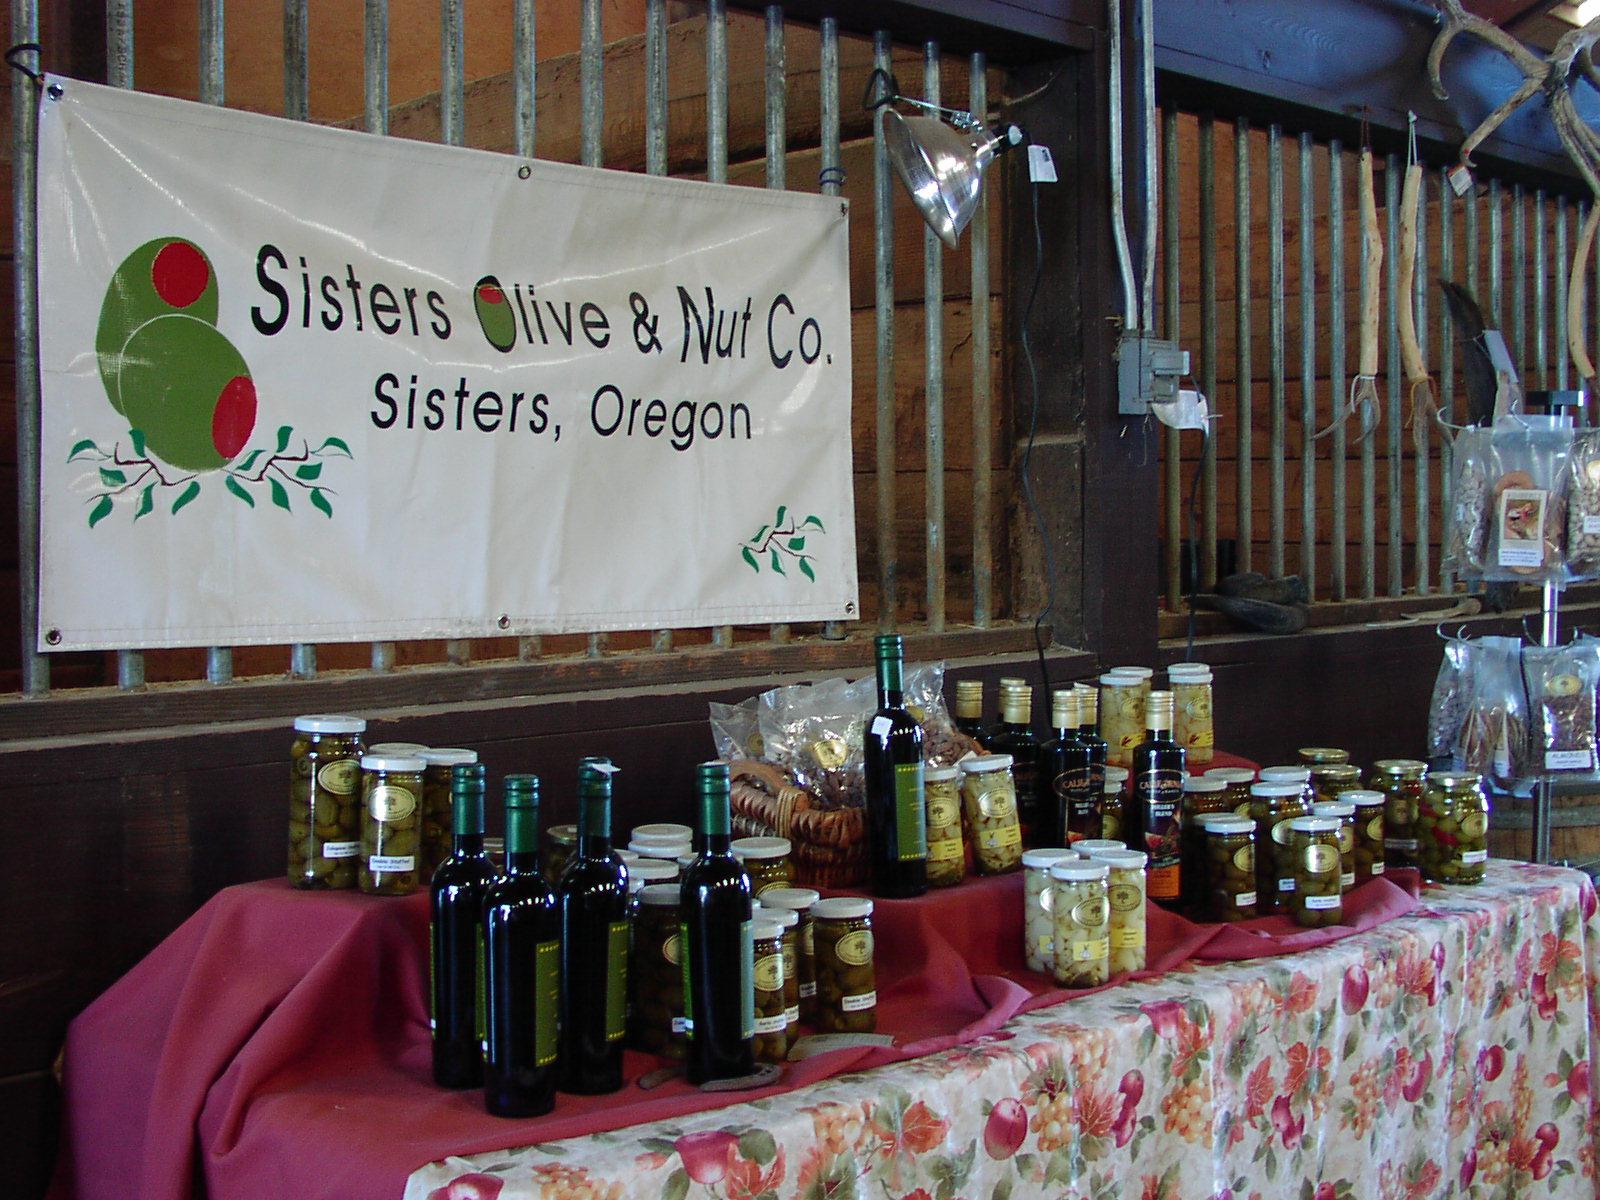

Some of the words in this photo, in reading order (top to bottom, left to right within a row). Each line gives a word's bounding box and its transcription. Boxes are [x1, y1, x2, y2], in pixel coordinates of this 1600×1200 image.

[250, 244, 452, 340] Sisters
[474, 274, 611, 354] Olive
[629, 291, 663, 354] &
[677, 280, 752, 365] Nut
[767, 293, 833, 365] Co.
[370, 372, 561, 442] Sisters,
[590, 384, 752, 452] Oregon
